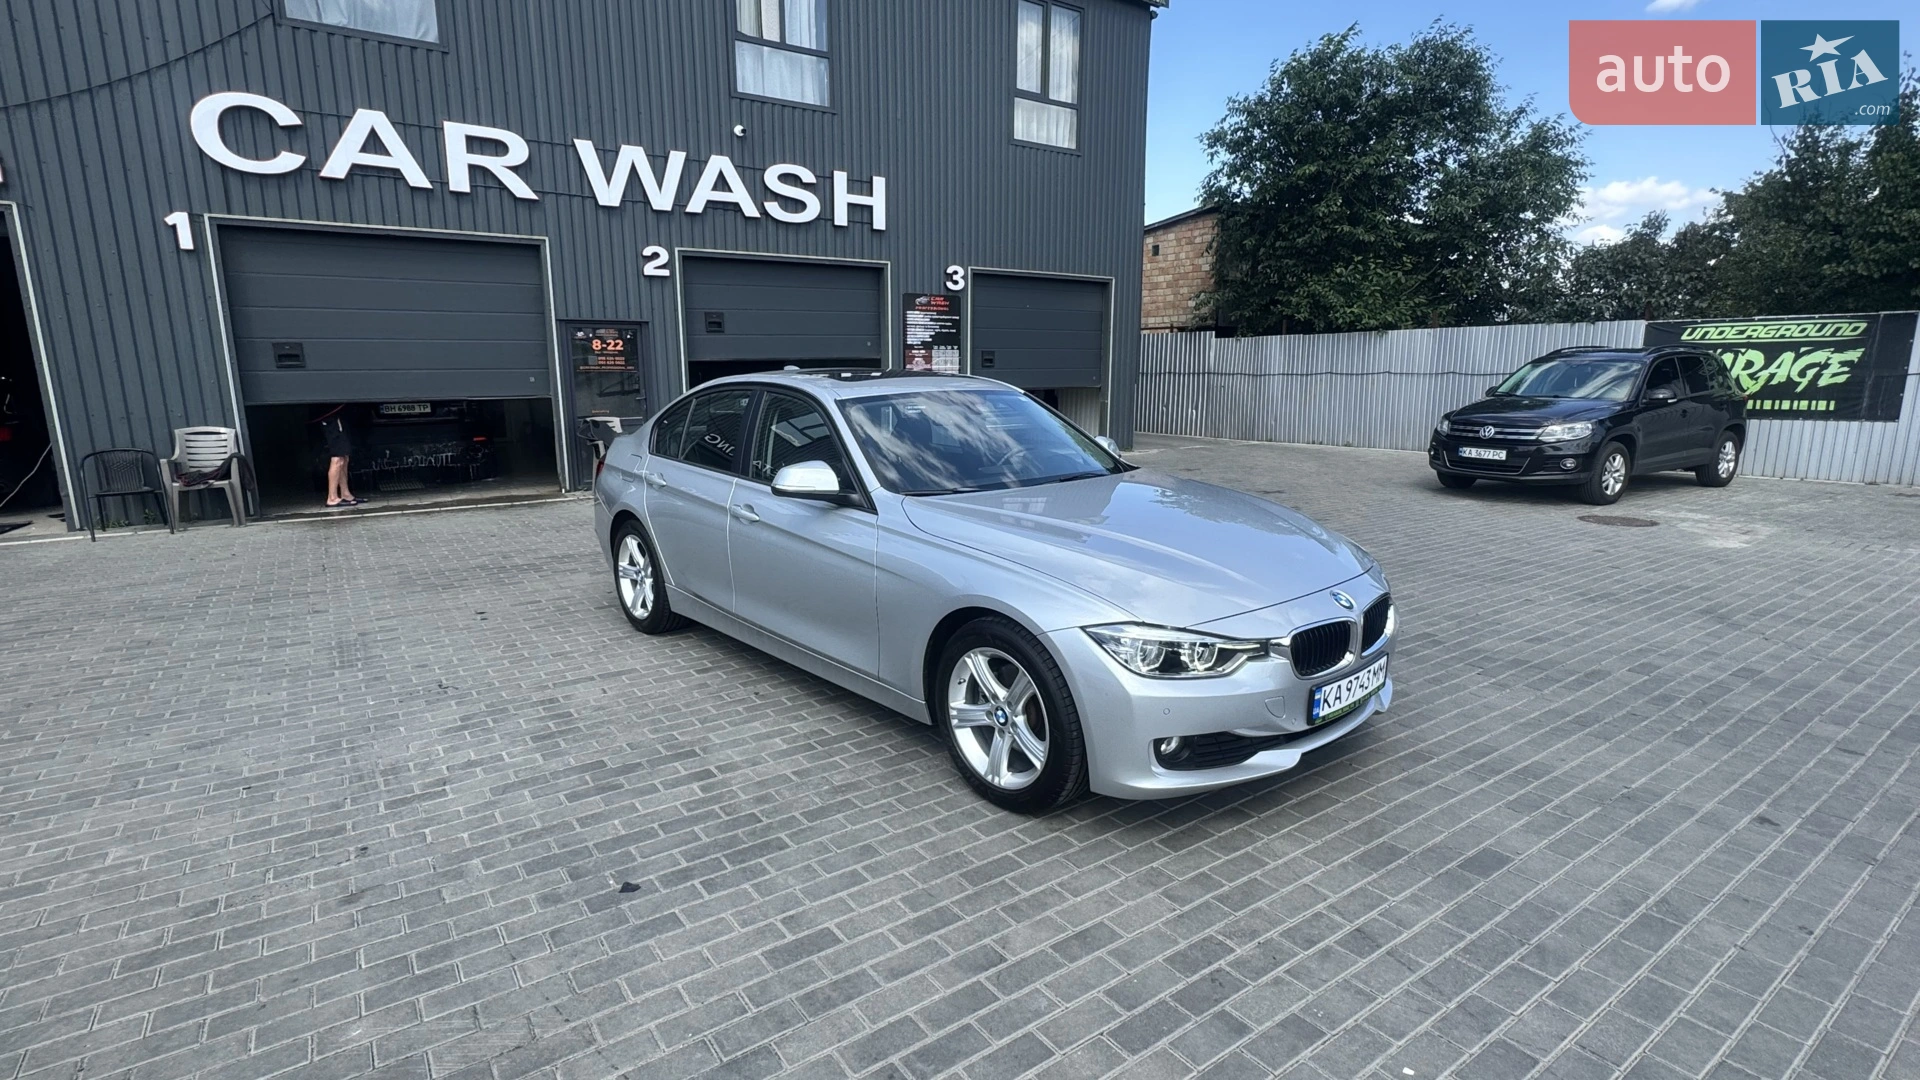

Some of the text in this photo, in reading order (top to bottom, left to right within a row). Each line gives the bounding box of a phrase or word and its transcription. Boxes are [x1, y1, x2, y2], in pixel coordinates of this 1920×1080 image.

[189, 91, 887, 231] CAR WASH
[164, 211, 195, 251] 1
[642, 245, 670, 277] 2
[945, 264, 966, 291] 3
[592, 339, 624, 351] 8-22
[1680, 322, 1868, 341] UNDERGROUND
[1321, 683, 1342, 711] KA
[1345, 669, 1371, 702] 9743
